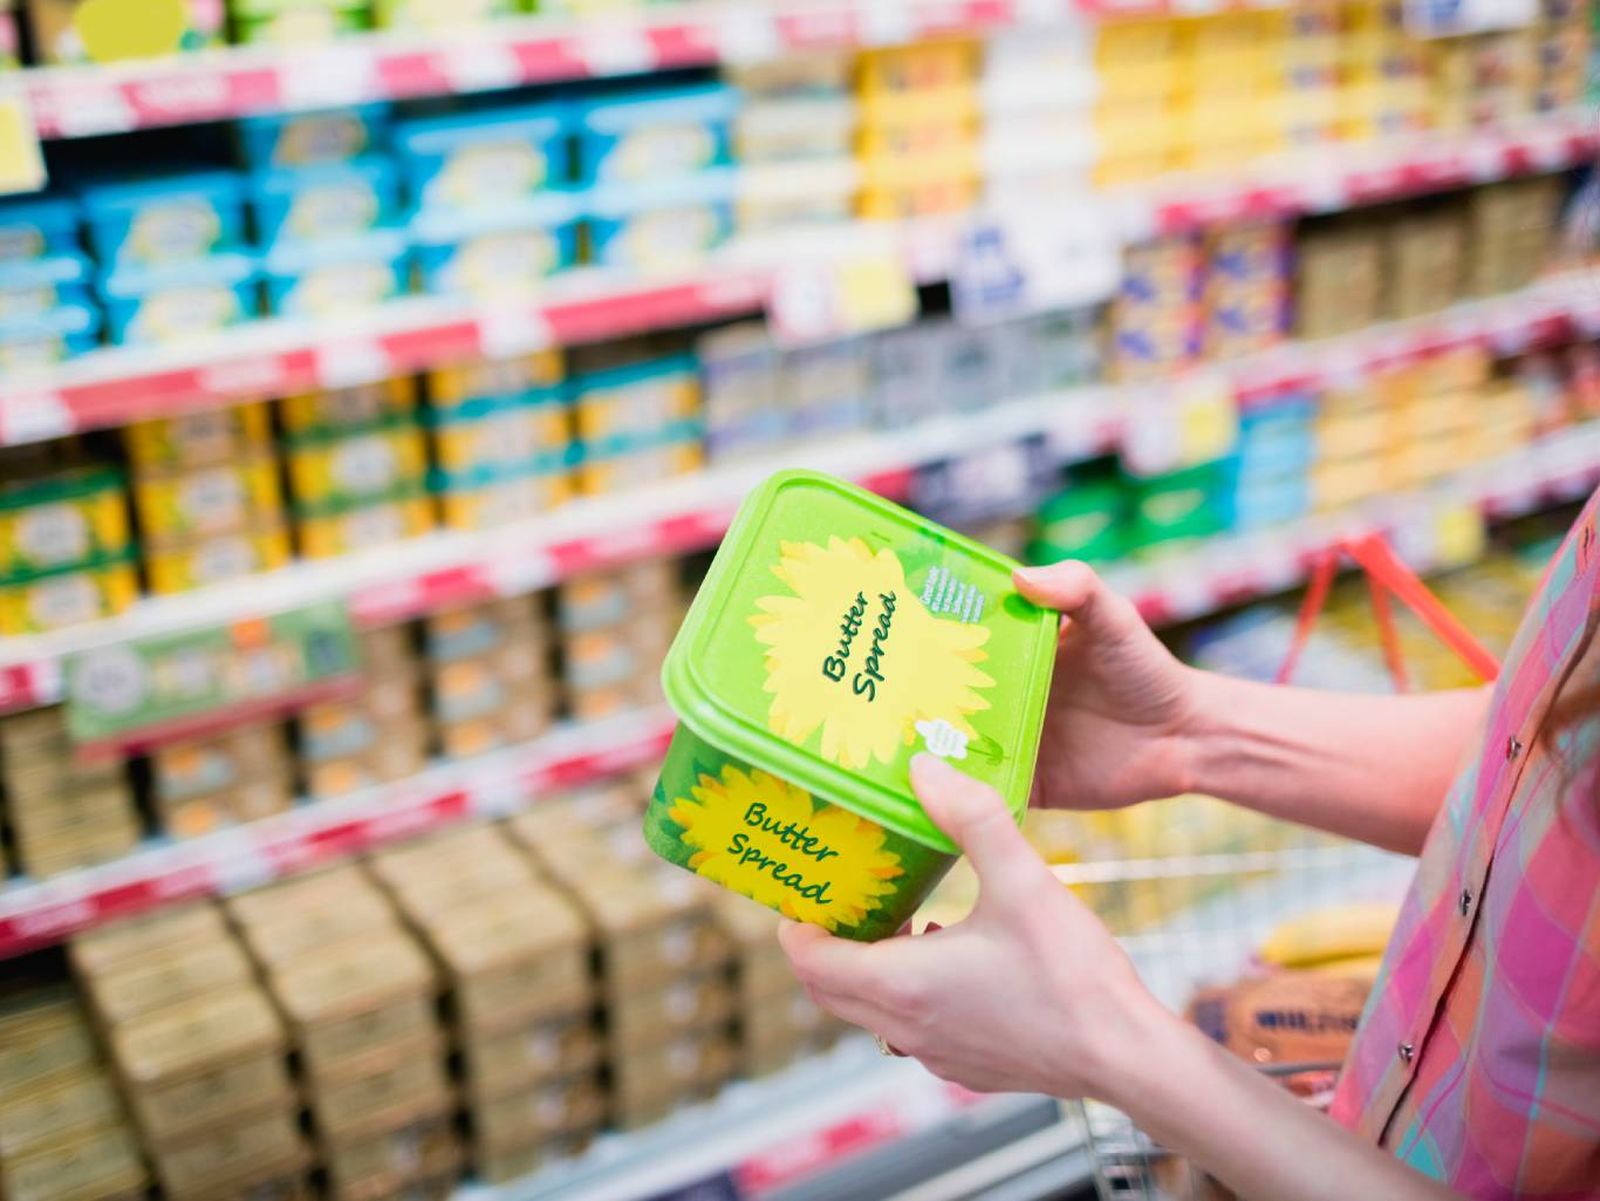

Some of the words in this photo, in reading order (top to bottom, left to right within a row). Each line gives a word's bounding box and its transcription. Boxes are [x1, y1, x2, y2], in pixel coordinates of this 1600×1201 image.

[822, 591, 868, 682] Butter
[853, 592, 897, 702] Spread
[727, 833, 833, 905] Spread
[744, 802, 838, 862] Butter
